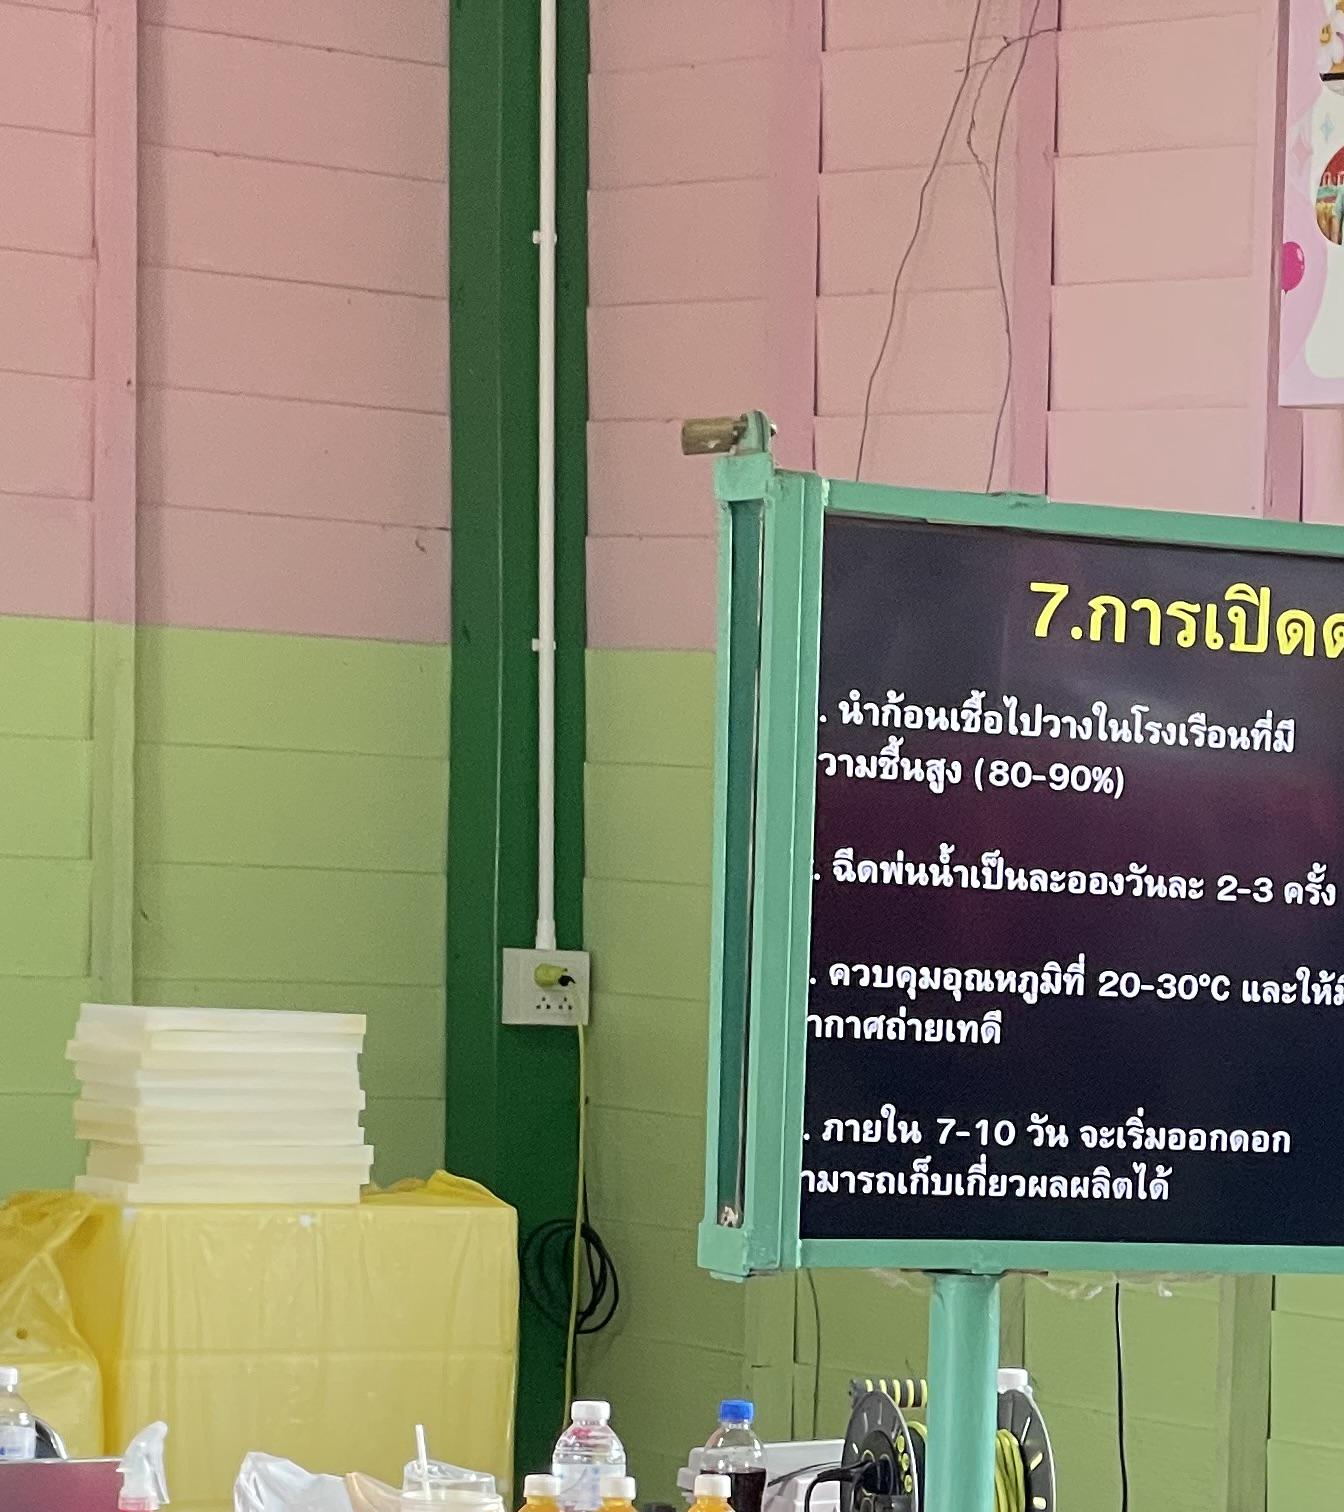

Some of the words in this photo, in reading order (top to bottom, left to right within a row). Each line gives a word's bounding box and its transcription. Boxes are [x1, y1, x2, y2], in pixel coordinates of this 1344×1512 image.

[837, 690, 1295, 753] นำก้อนเชื้อไปวางในโรงเรือนที่มี
[974, 757, 1123, 800] (80-90%)
[832, 843, 1204, 900] ฉีดพ่นน้ำเป็นละอองวันละ
[1216, 875, 1273, 903] 2-3
[1284, 863, 1336, 906] ครั้ง
[828, 953, 1085, 1004] ควบคุมอุณหภูมิที่
[821, 1104, 922, 1143] ภายใน
[936, 1117, 1016, 1148] 7-10
[1026, 1112, 1069, 1148] วัน
[1079, 1108, 1291, 1153] จะเริ่มออกดอก
